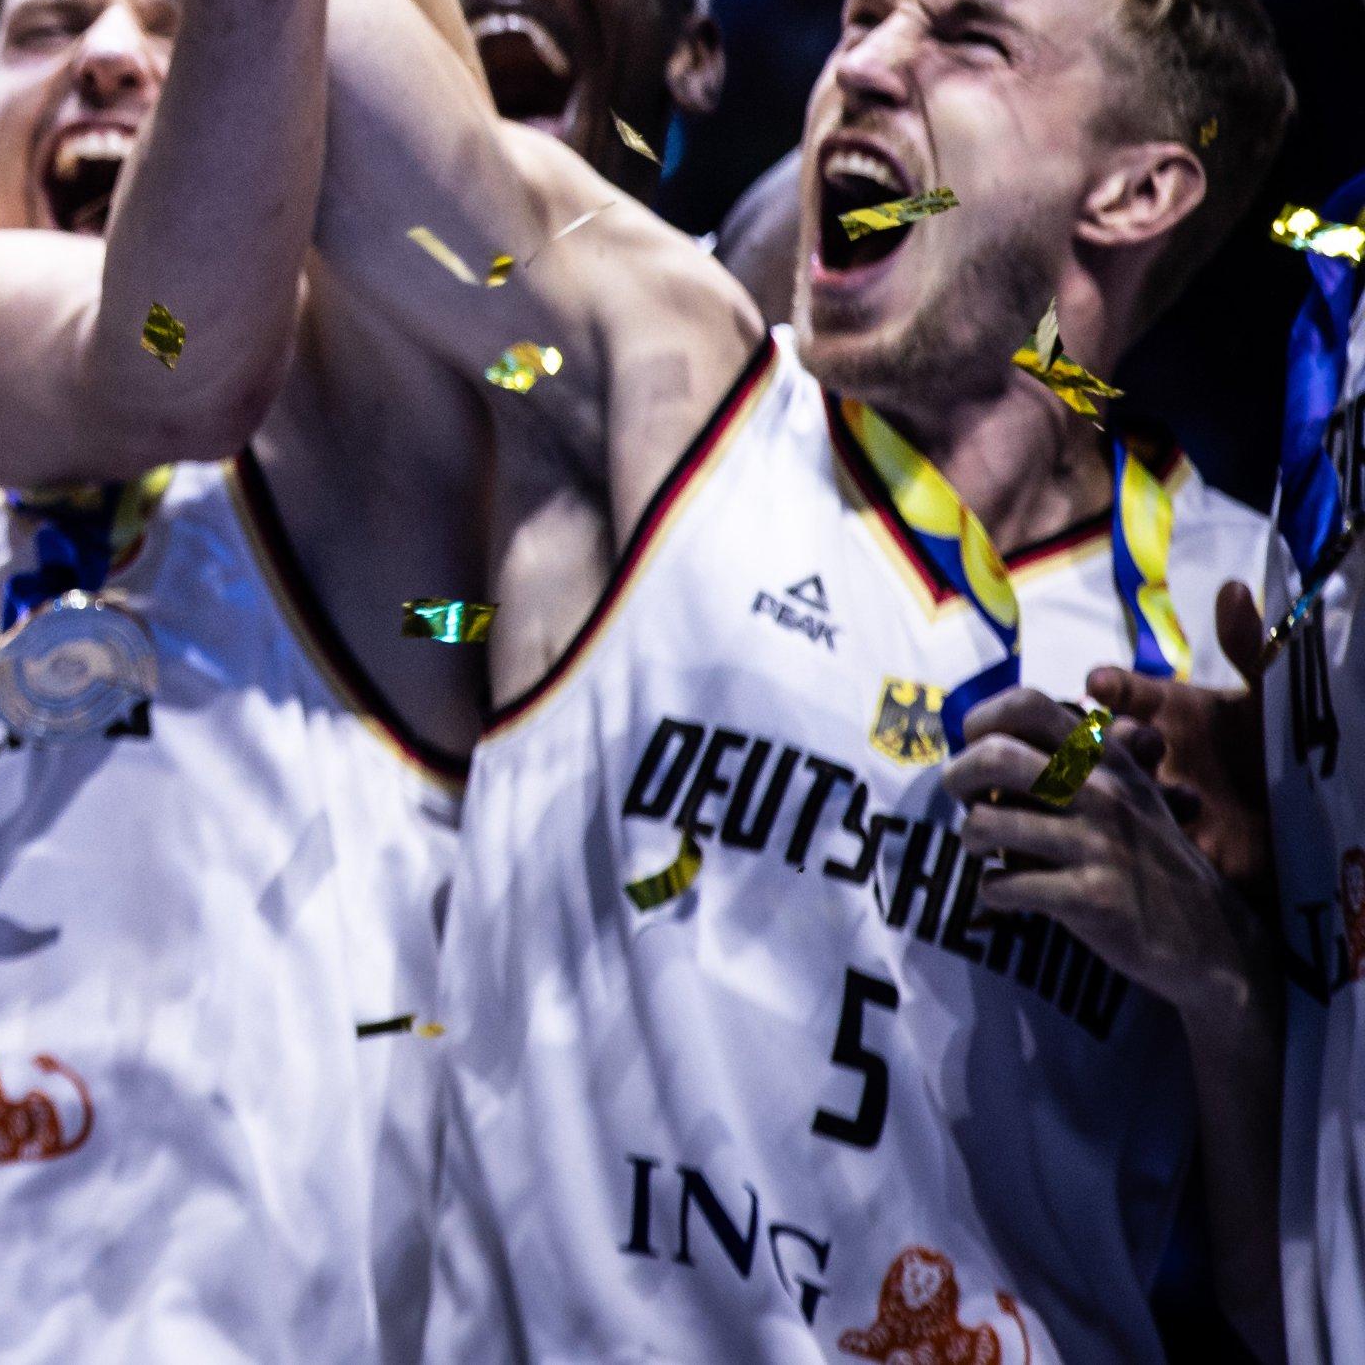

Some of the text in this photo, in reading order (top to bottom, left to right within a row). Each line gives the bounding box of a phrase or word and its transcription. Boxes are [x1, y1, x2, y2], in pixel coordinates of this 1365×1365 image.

[751, 590, 841, 651] PEAK
[810, 968, 899, 1151] 5
[619, 1151, 831, 1327] ING
